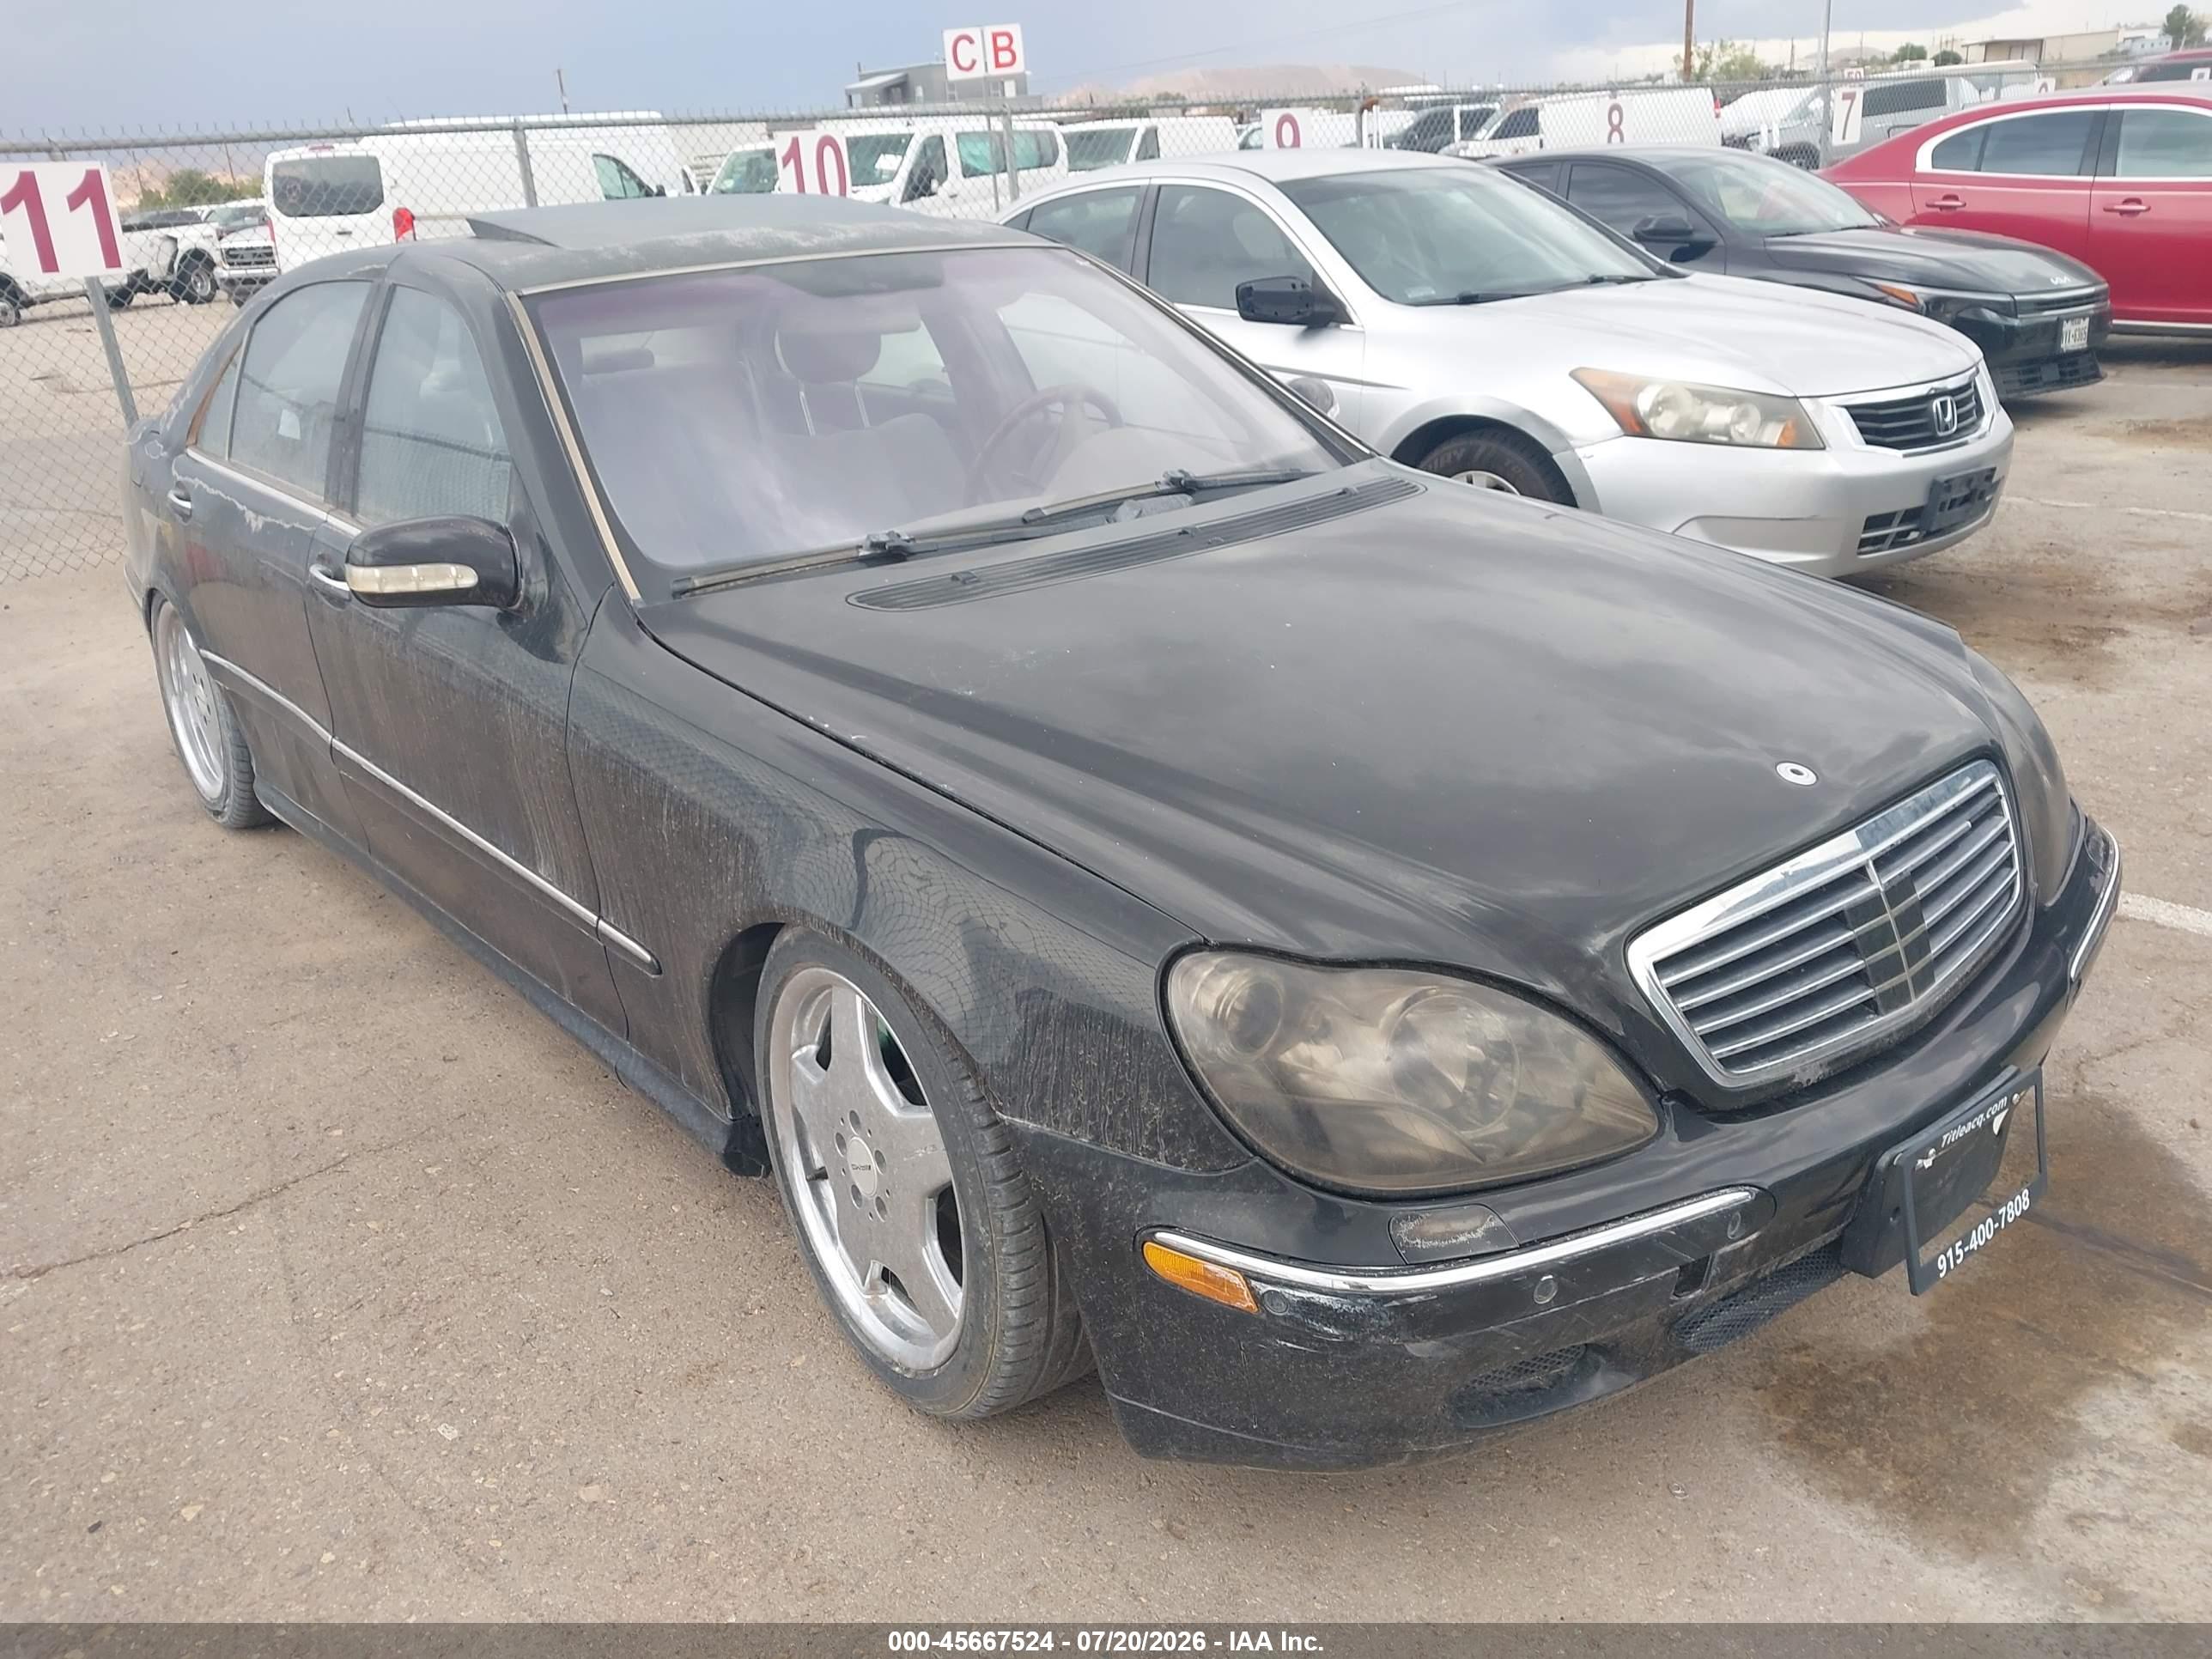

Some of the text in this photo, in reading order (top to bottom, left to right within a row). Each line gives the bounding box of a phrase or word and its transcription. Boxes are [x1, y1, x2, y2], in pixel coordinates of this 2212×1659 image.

[952, 31, 1017, 71] C B
[1607, 103, 1625, 143] 8
[1842, 91, 1856, 141] 7
[782, 134, 847, 197] 10
[0, 169, 122, 273] 11
[1942, 1096, 2008, 1148] Titleacq.com
[1937, 1188, 2030, 1279] 915-400-7808
